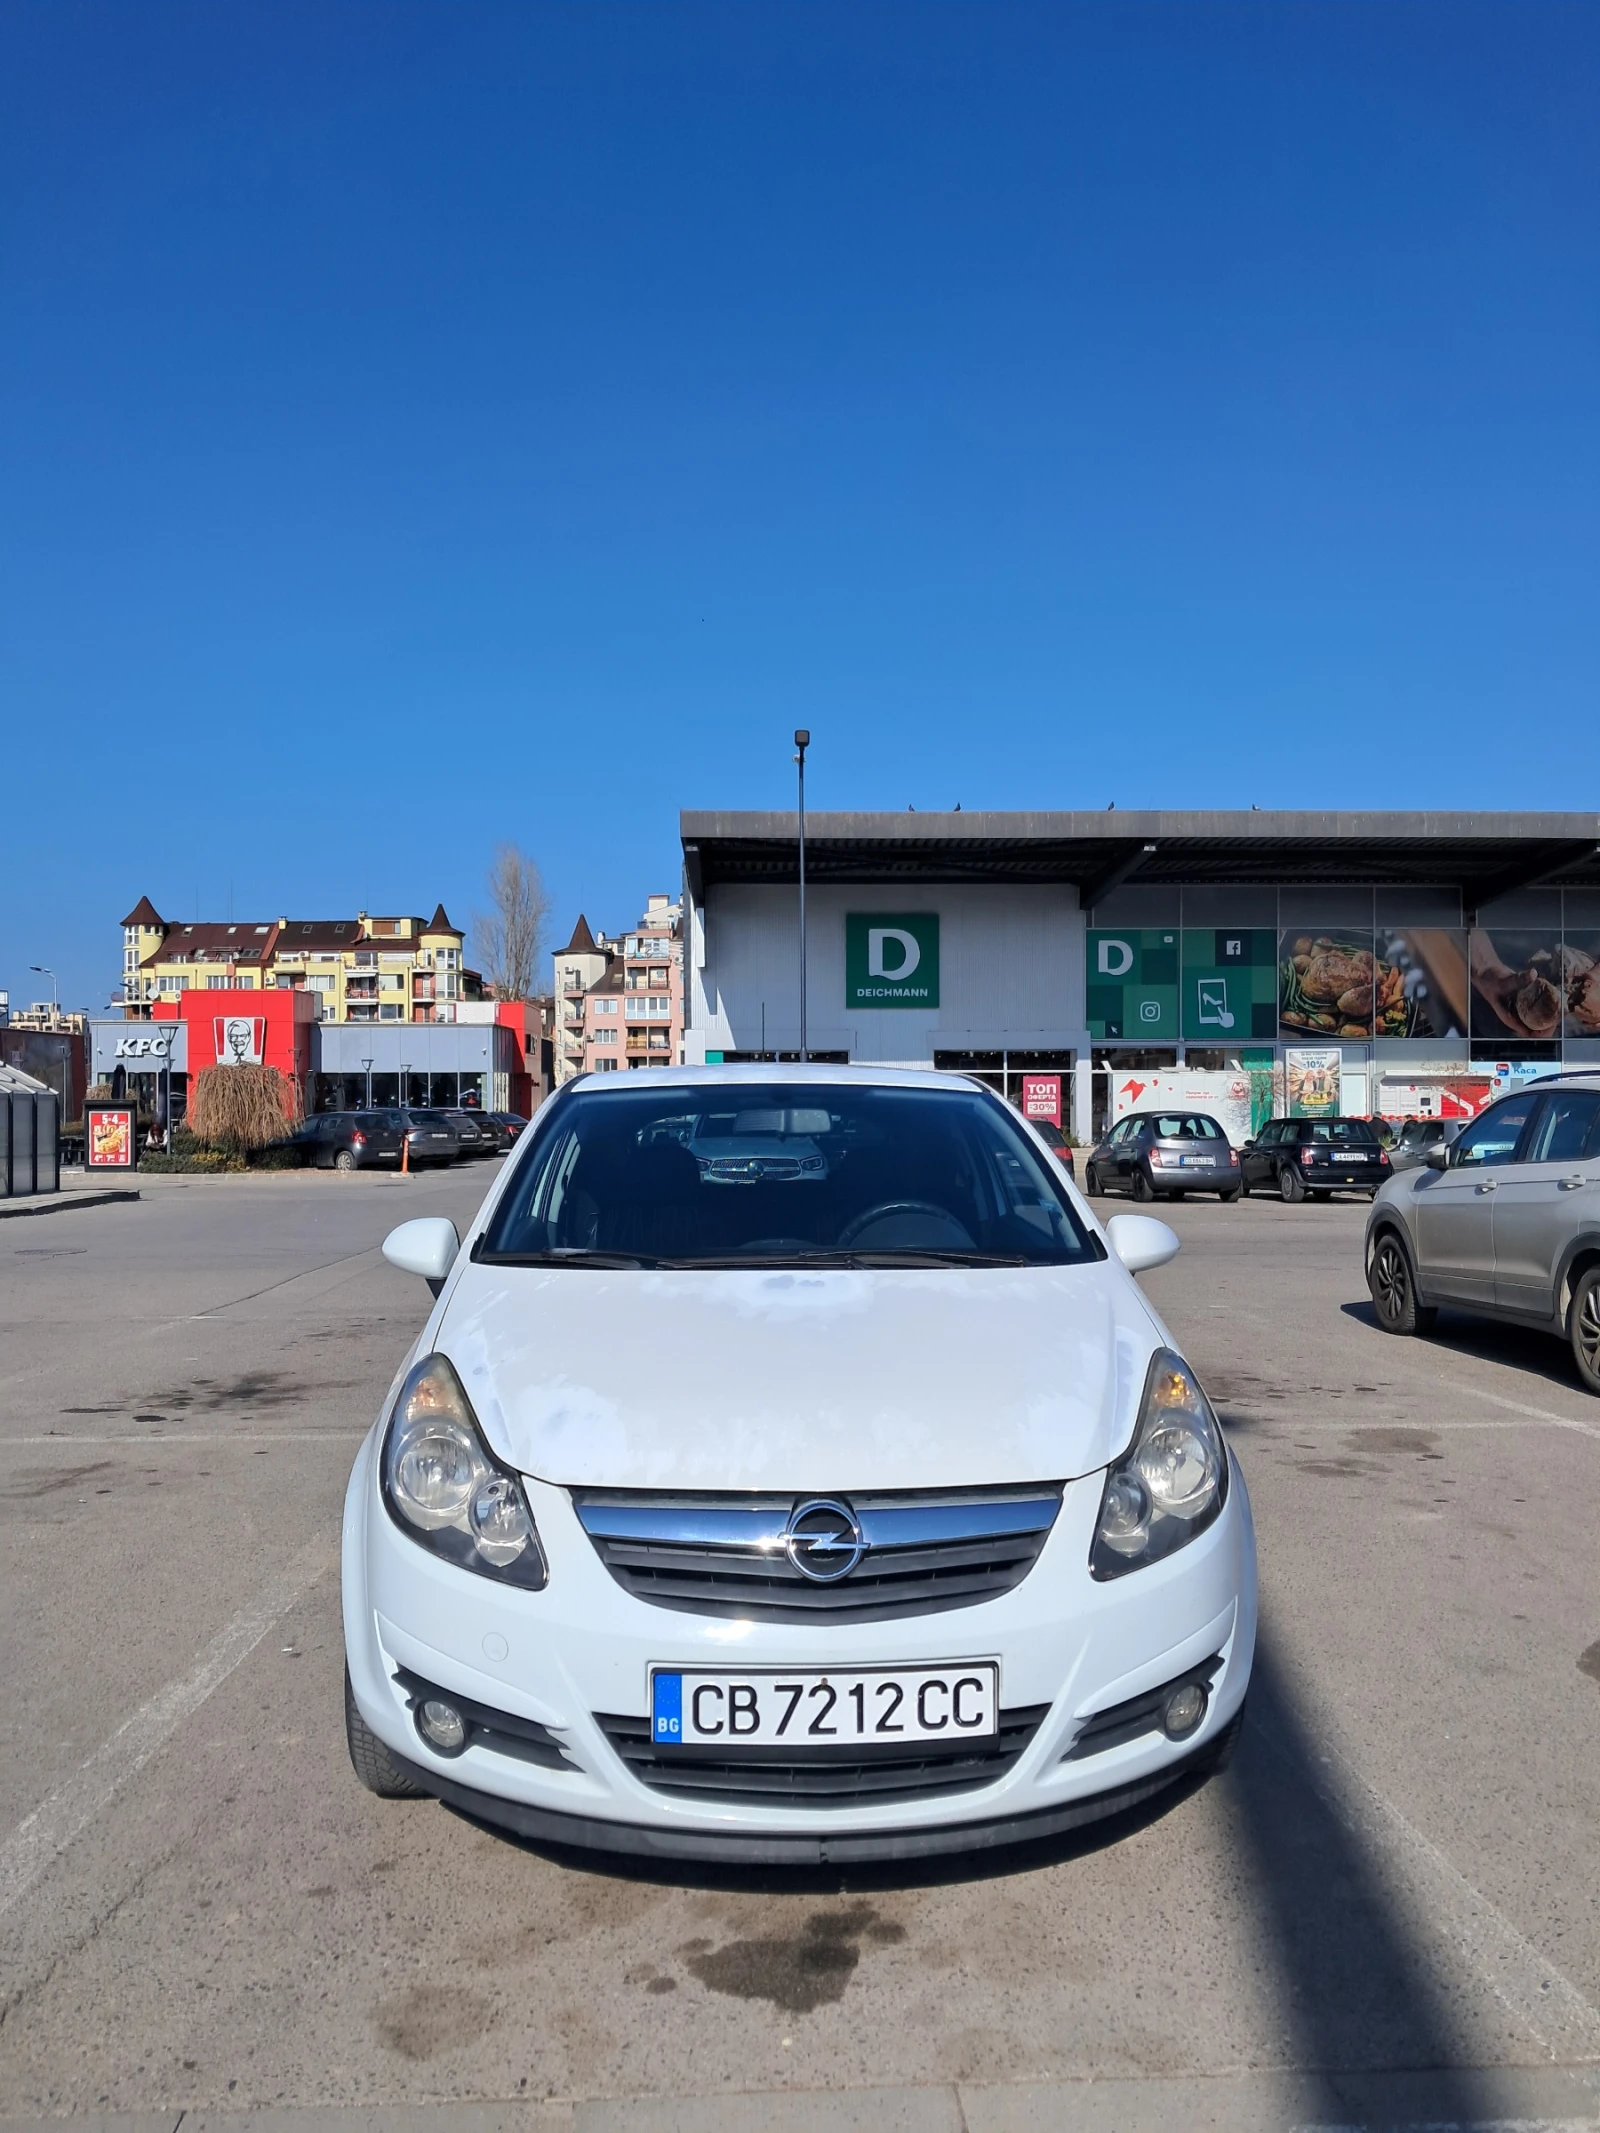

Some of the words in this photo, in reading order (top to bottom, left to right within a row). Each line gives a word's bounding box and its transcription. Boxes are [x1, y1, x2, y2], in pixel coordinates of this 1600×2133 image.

[868, 929, 920, 981] D
[1098, 940, 1134, 975] D
[857, 988, 928, 997] DEICHMANN
[114, 1038, 167, 1056] KFC
[1027, 1084, 1057, 1094] ТОП
[774, 1682, 904, 1736] 7212
[657, 1717, 680, 1733] BG
